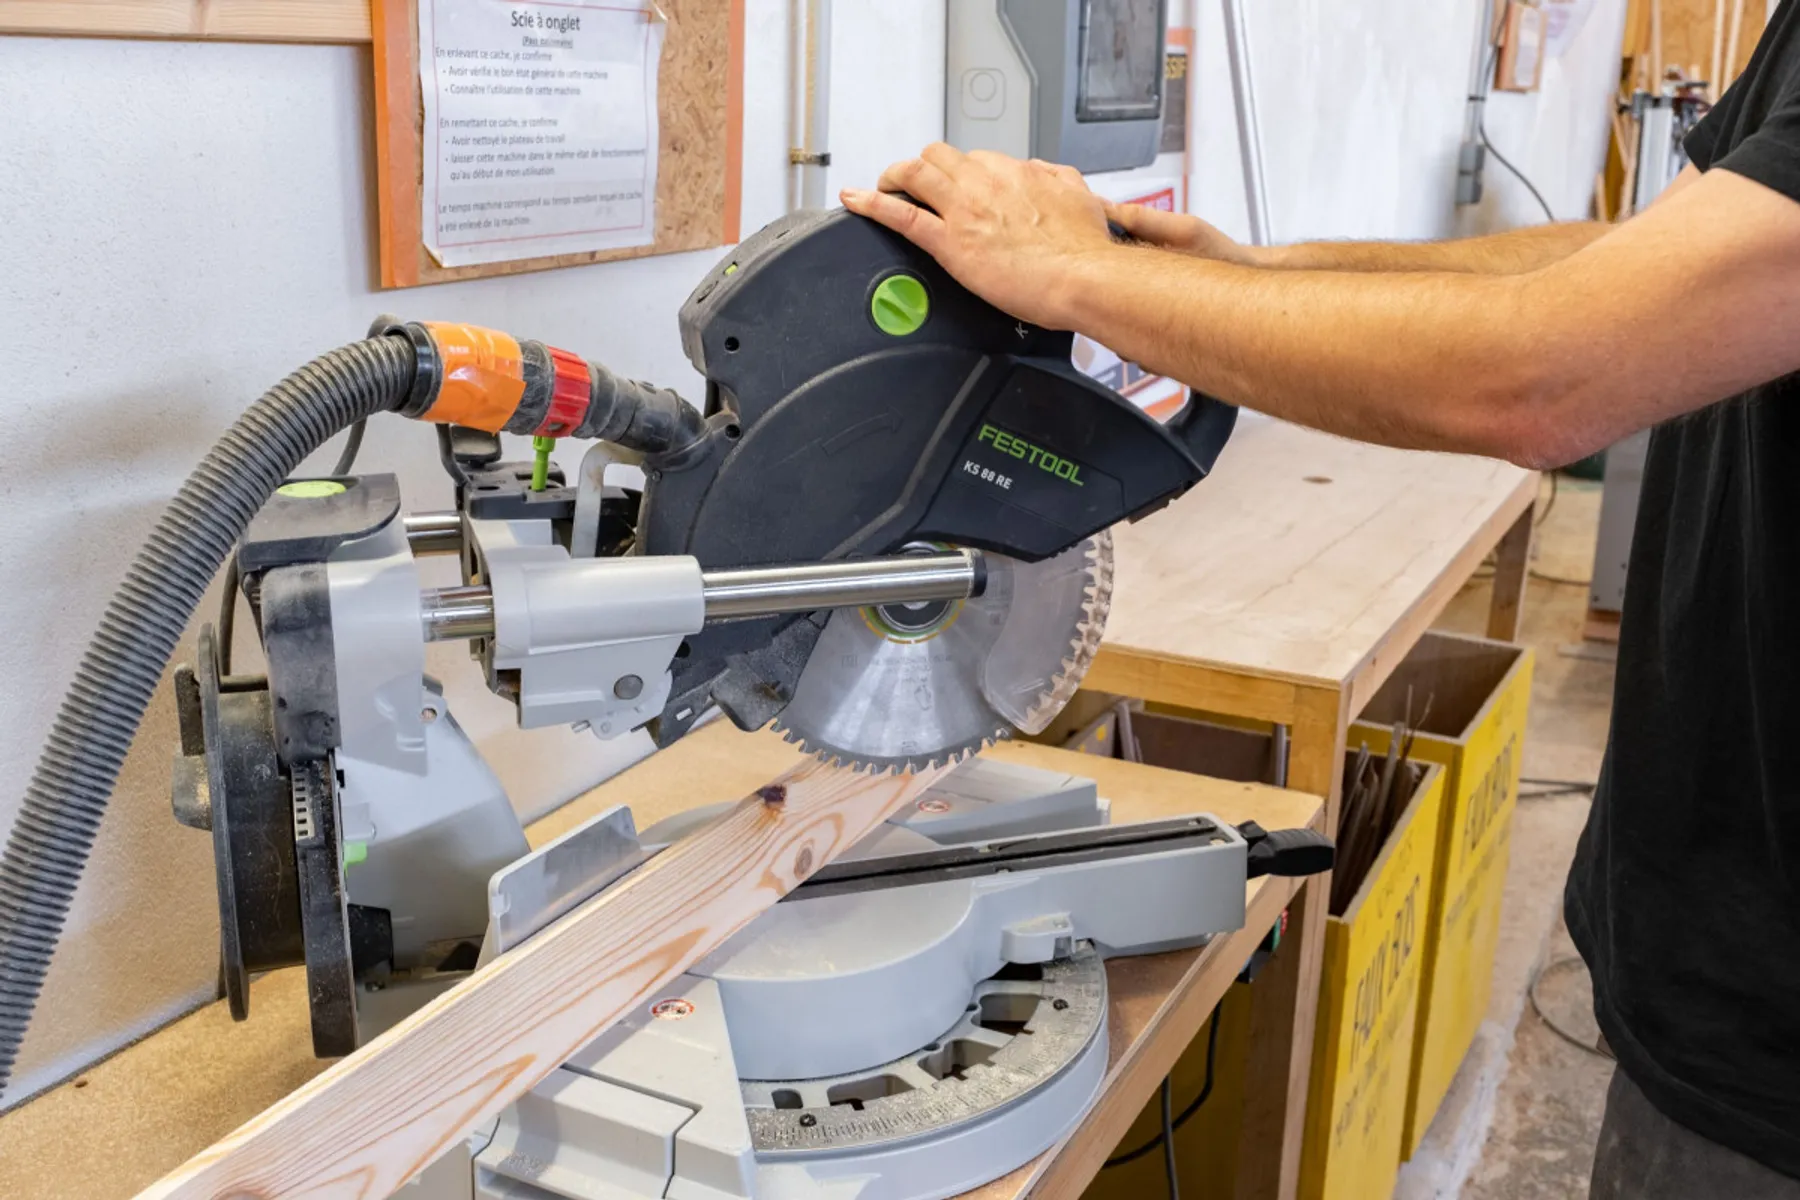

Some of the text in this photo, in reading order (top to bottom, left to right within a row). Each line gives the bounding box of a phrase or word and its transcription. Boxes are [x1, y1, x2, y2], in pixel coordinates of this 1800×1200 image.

[511, 10, 581, 34] Scie à onglet
[451, 135, 470, 145] Avoir
[472, 135, 499, 147] nettoyé
[501, 134, 508, 144] le
[509, 134, 534, 147] plateau
[536, 134, 544, 144] de
[978, 424, 1084, 487] FESTOOL
[963, 460, 1013, 490] KS 88 RE
